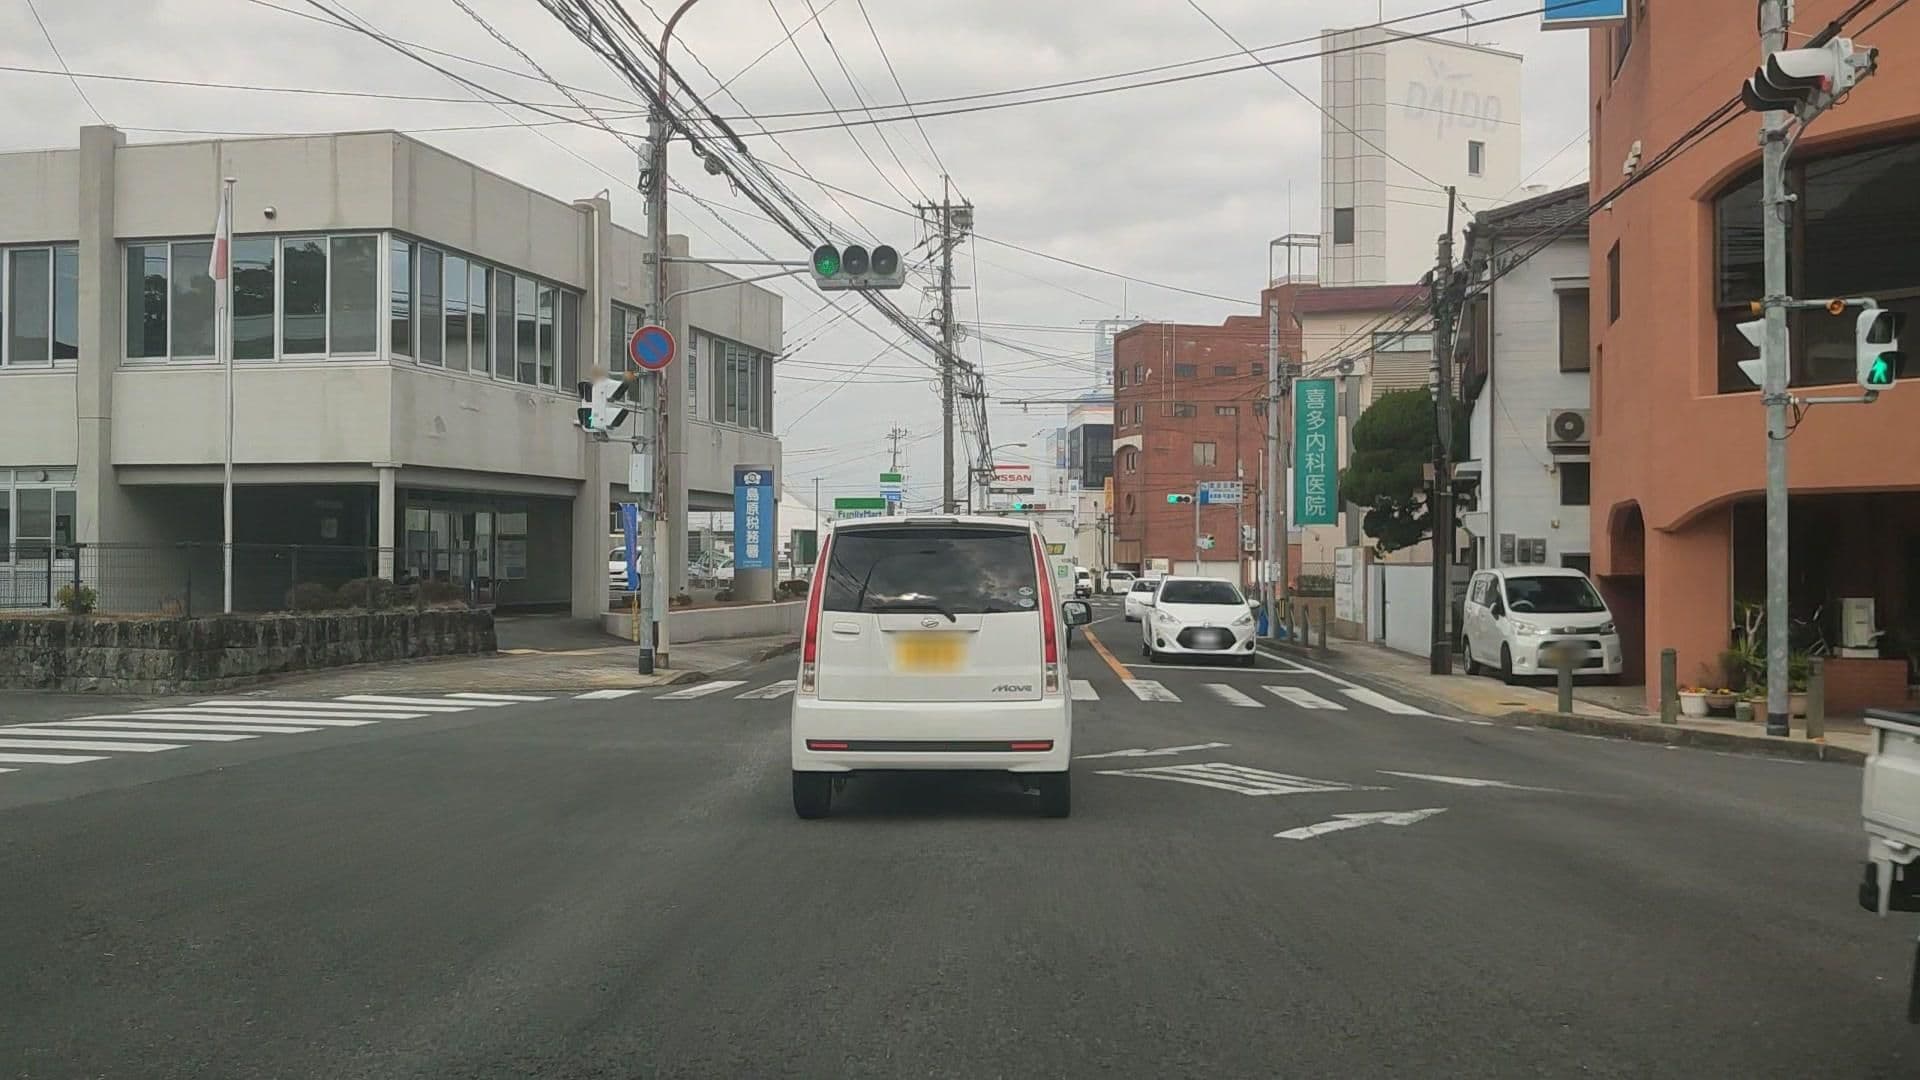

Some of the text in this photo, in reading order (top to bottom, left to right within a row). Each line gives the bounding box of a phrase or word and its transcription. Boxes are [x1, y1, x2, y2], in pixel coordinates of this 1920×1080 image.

[1305, 388, 1326, 517] 喜多内科医院
[745, 486, 760, 559] 島原税務署
